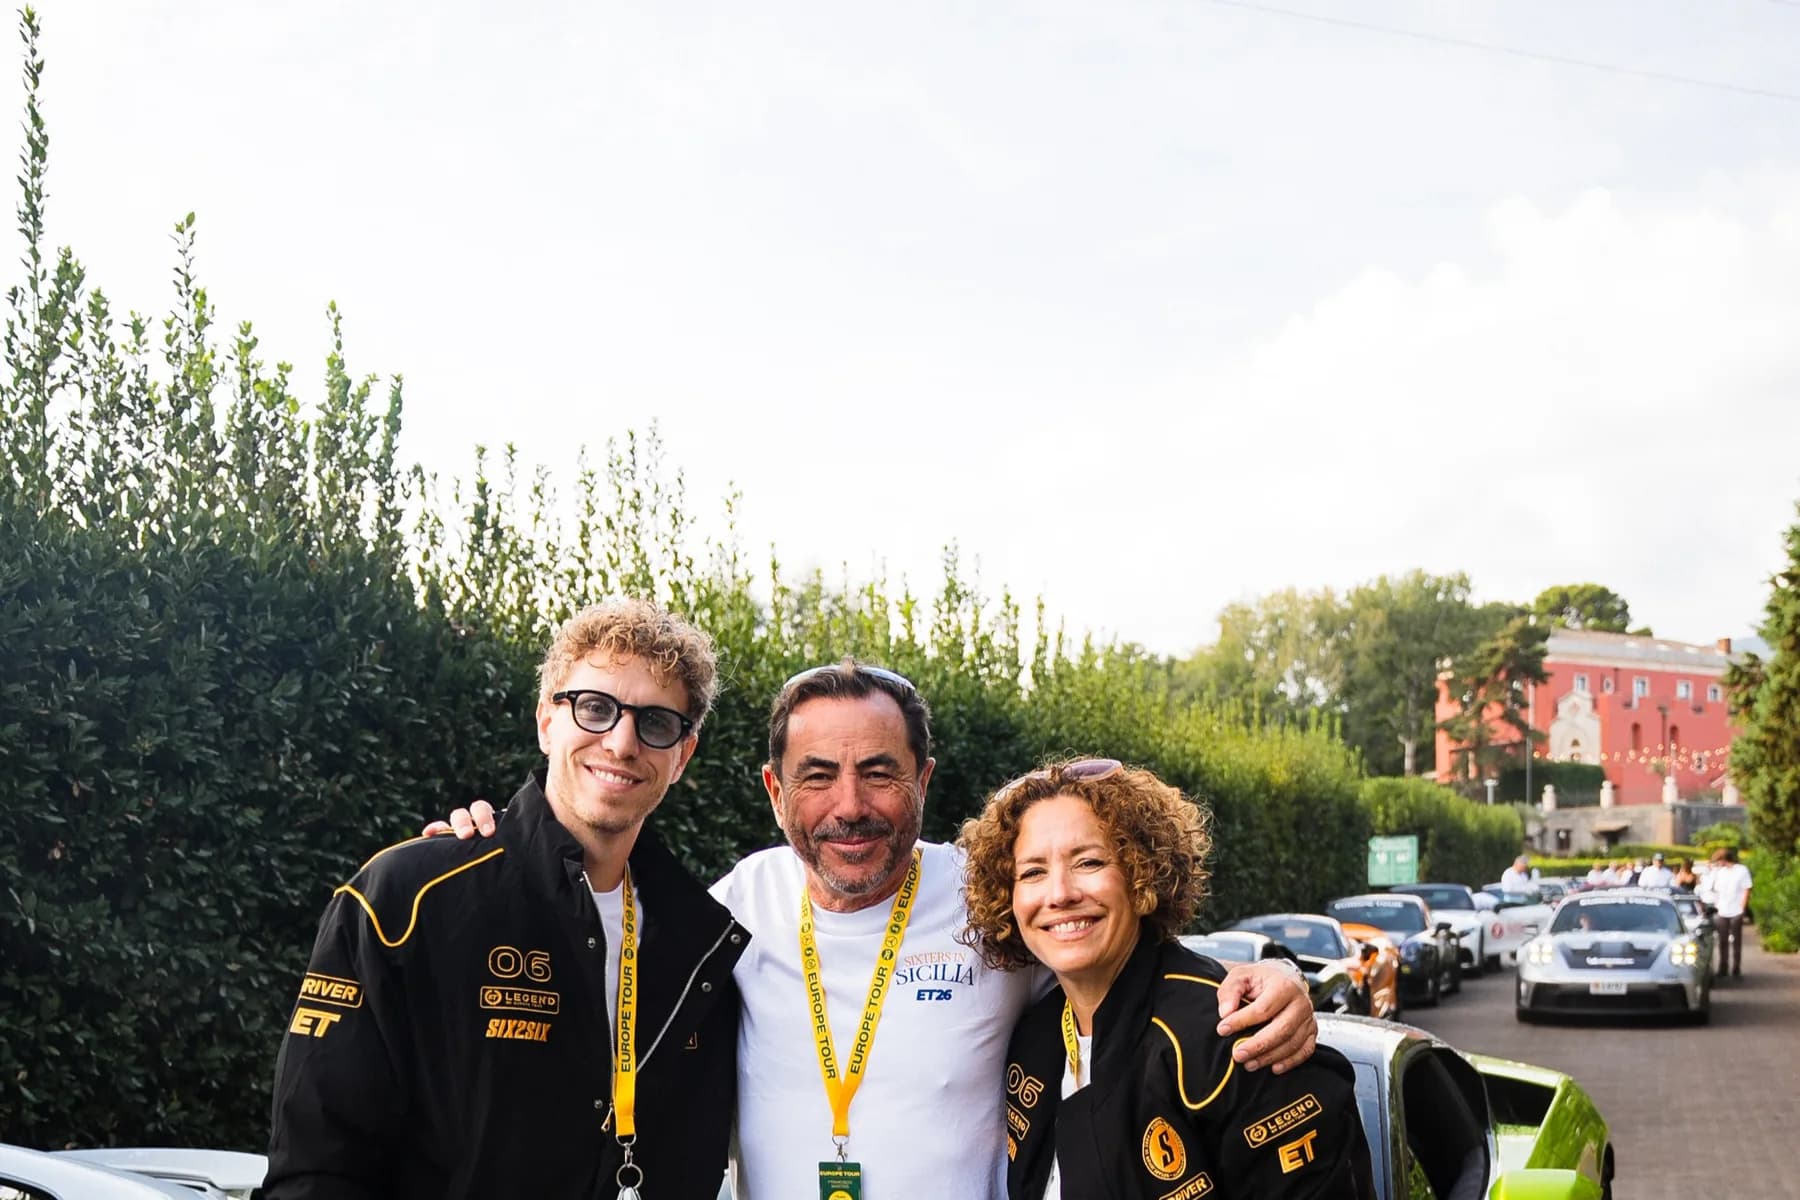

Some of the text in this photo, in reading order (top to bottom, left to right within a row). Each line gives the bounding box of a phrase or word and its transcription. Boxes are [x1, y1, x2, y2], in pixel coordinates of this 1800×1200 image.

[488, 945, 552, 983] 06
[895, 963, 974, 986] SICILIA
[302, 978, 358, 1001] RIVER
[505, 991, 556, 1006] LEGEND
[916, 989, 952, 1001] ET26
[290, 1007, 342, 1038] ET
[485, 1018, 552, 1042] SIX2SIX
[620, 965, 633, 1073] EUROPE TOUR
[808, 972, 836, 1079] EUROPE TOUR
[850, 966, 888, 1075] EUROPE TOUR
[1007, 1063, 1045, 1109] 06
[1266, 1100, 1314, 1131] LEGEND
[1278, 1128, 1318, 1174] ET
